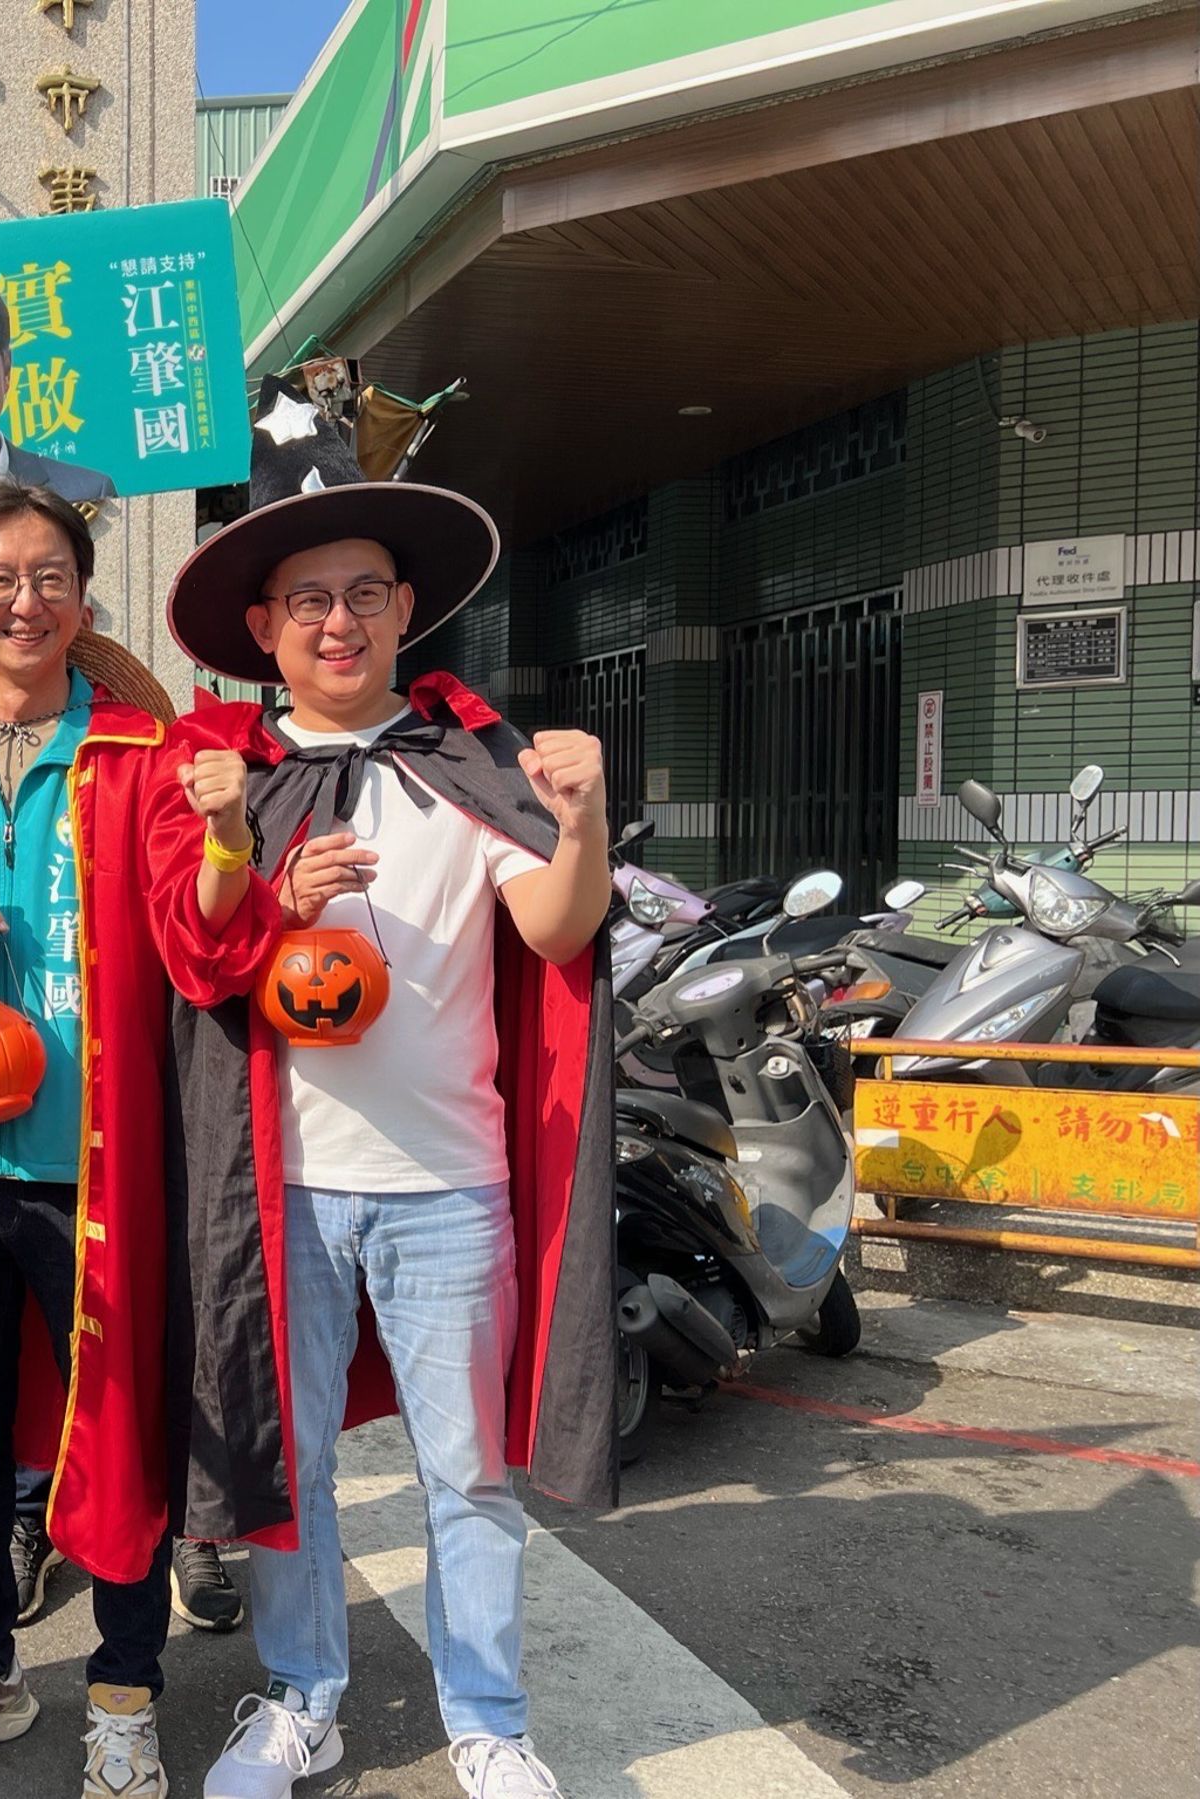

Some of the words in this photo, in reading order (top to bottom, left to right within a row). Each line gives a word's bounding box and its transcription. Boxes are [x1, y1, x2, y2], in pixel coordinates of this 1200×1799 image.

[121, 280, 190, 460] 江肇國
[1036, 570, 1111, 587] 代理收件處
